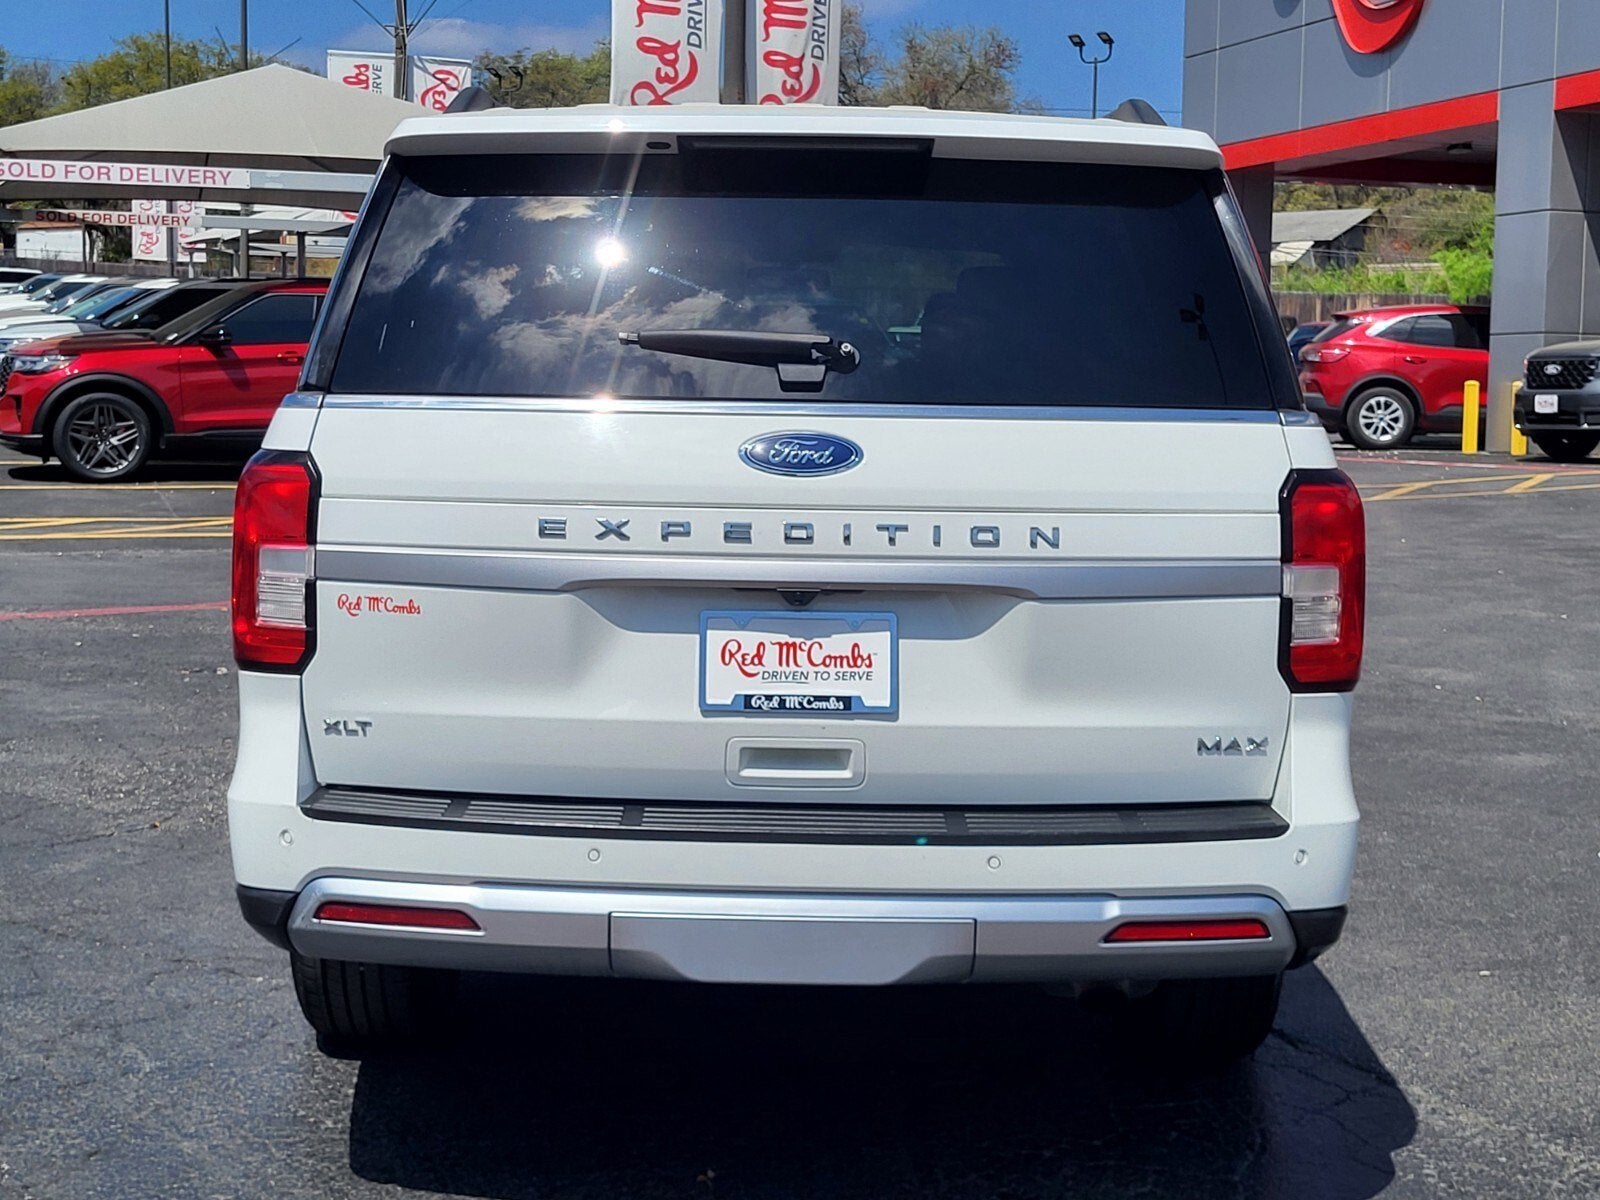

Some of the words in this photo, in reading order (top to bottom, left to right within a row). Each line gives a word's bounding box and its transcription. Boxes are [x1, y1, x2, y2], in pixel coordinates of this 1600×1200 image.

[372, 63, 383, 94] RVE
[64, 164, 111, 181] FOR
[119, 166, 232, 186] DELIVERY
[35, 210, 77, 222] SOLD
[82, 212, 113, 225] FOR
[117, 213, 190, 227] DELIVERY
[768, 438, 835, 464] Ford
[538, 517, 1061, 549] EXPEDITION
[337, 593, 362, 617] Red
[364, 596, 421, 614] McCombs
[720, 638, 766, 678] Red
[770, 640, 873, 669] McCombs
[761, 670, 810, 681] DRIVEN
[813, 671, 831, 681] TO
[833, 671, 873, 682] SERVE
[750, 695, 781, 711] Red
[780, 695, 845, 710] McCombs
[323, 719, 373, 738] XLT
[1197, 735, 1269, 757] MAX
